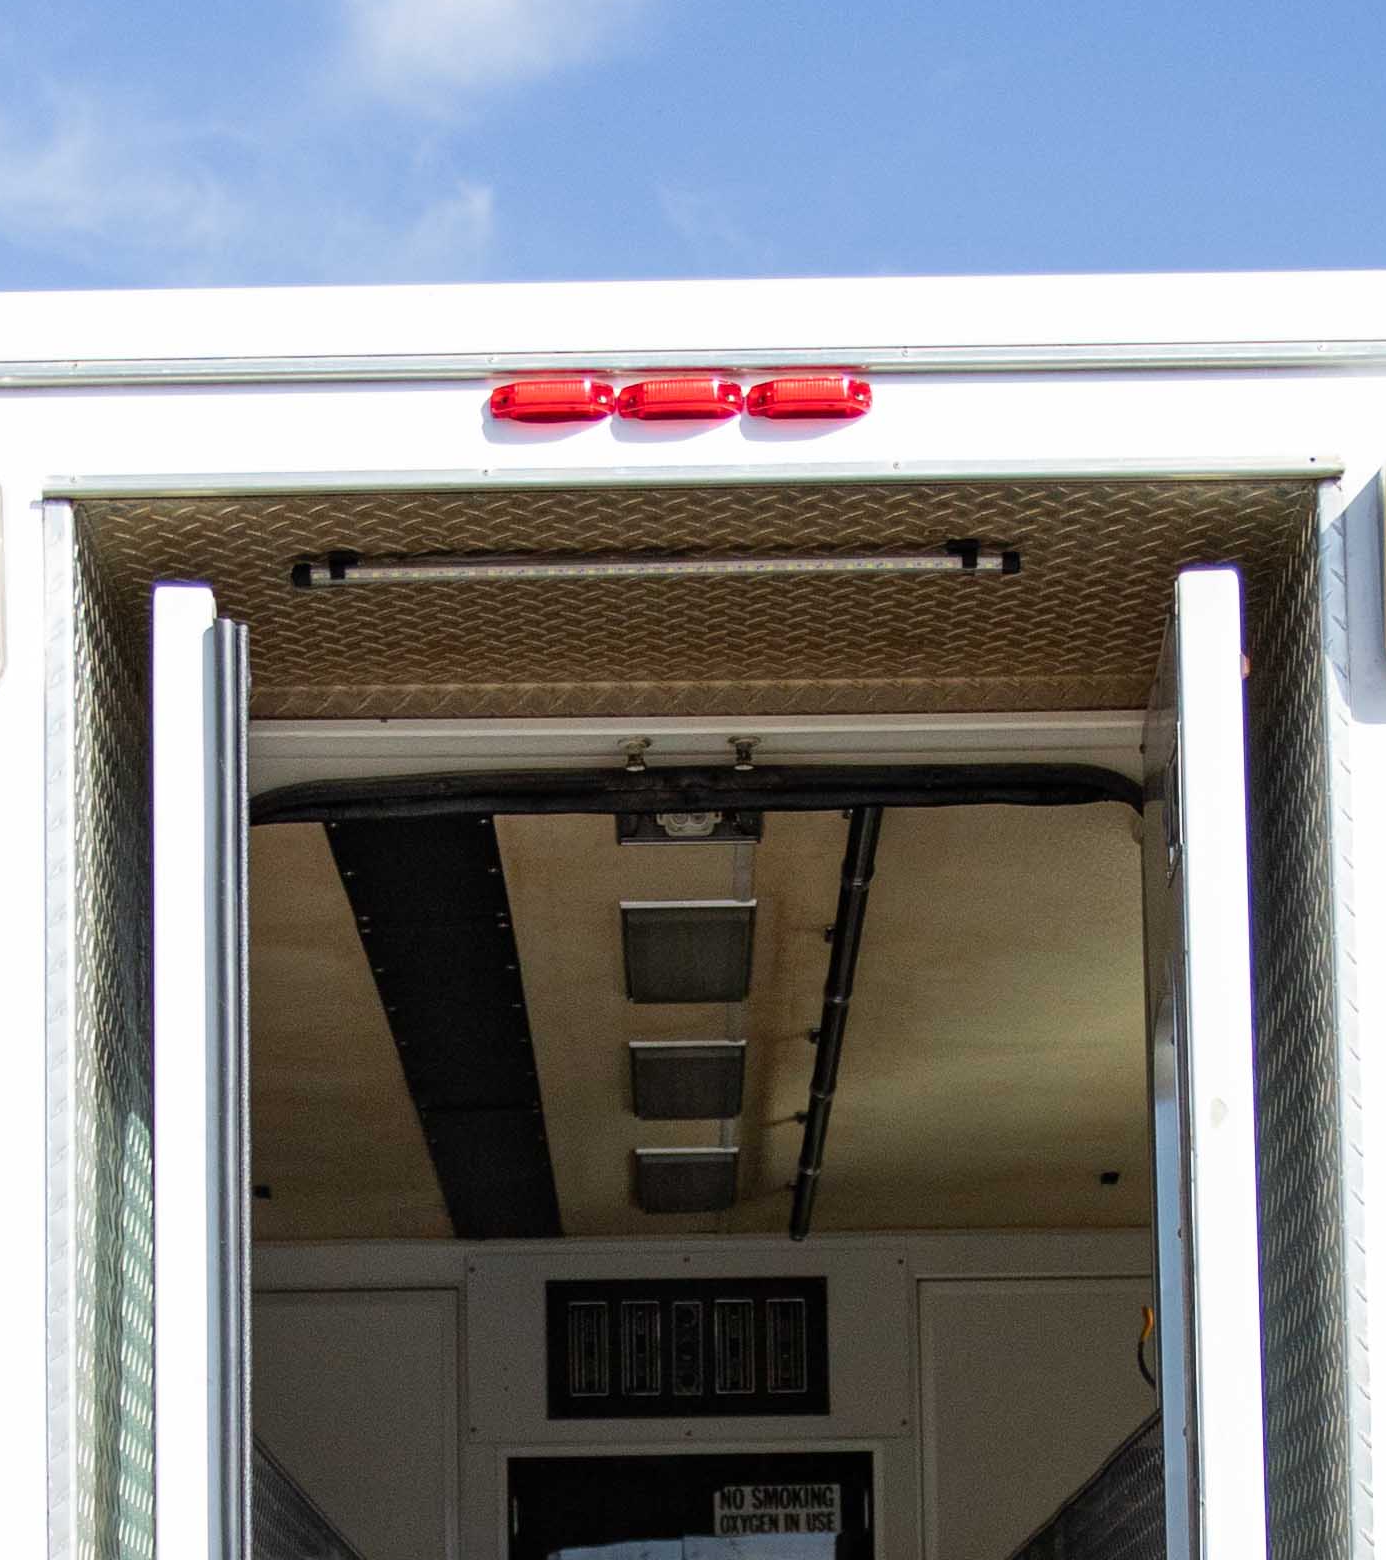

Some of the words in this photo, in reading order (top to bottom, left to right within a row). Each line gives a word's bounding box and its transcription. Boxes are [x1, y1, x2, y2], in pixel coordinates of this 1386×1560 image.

[719, 1487, 745, 1510] NO
[751, 1485, 834, 1510] SMOKING
[720, 1513, 779, 1534] OXYGEN
[783, 1513, 801, 1533] IN
[805, 1512, 835, 1532] USE
